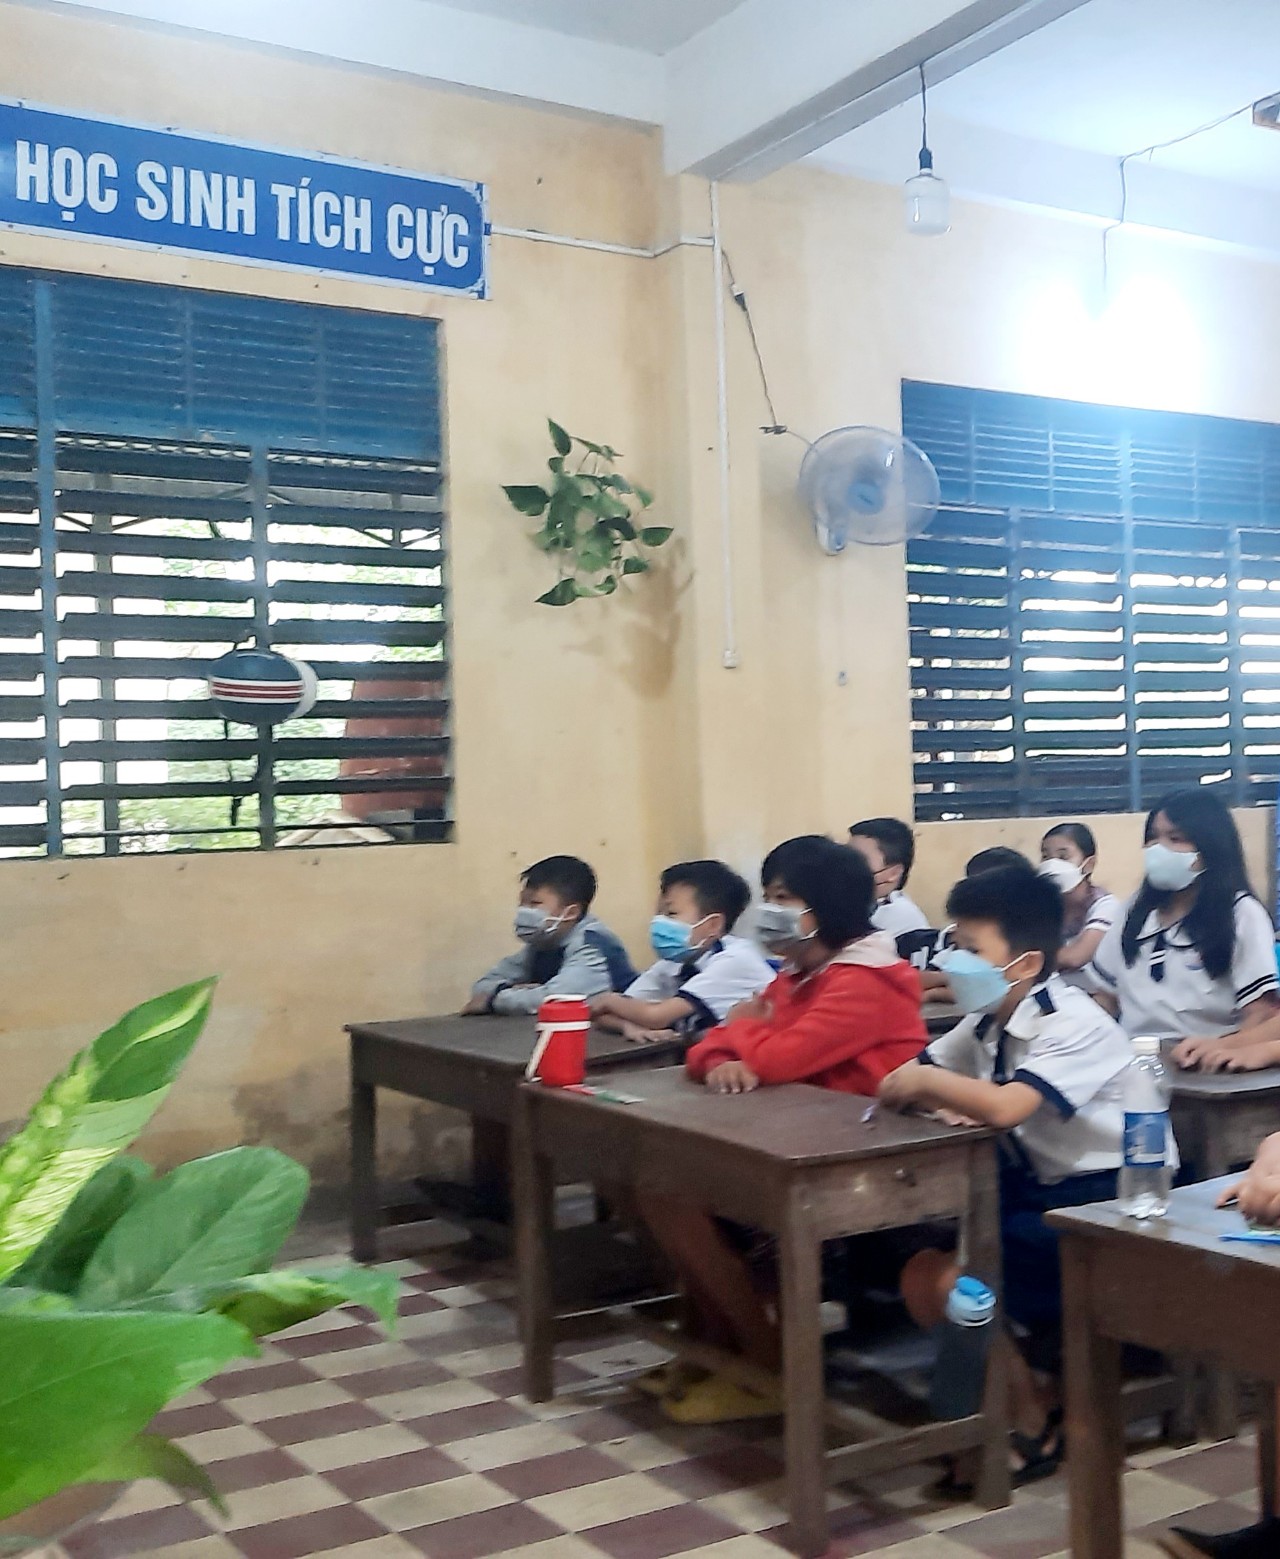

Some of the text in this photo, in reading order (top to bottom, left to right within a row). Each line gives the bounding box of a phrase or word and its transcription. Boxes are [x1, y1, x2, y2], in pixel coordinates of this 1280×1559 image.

[15, 139, 470, 276] HỌC SINH TÍCH CỰC
